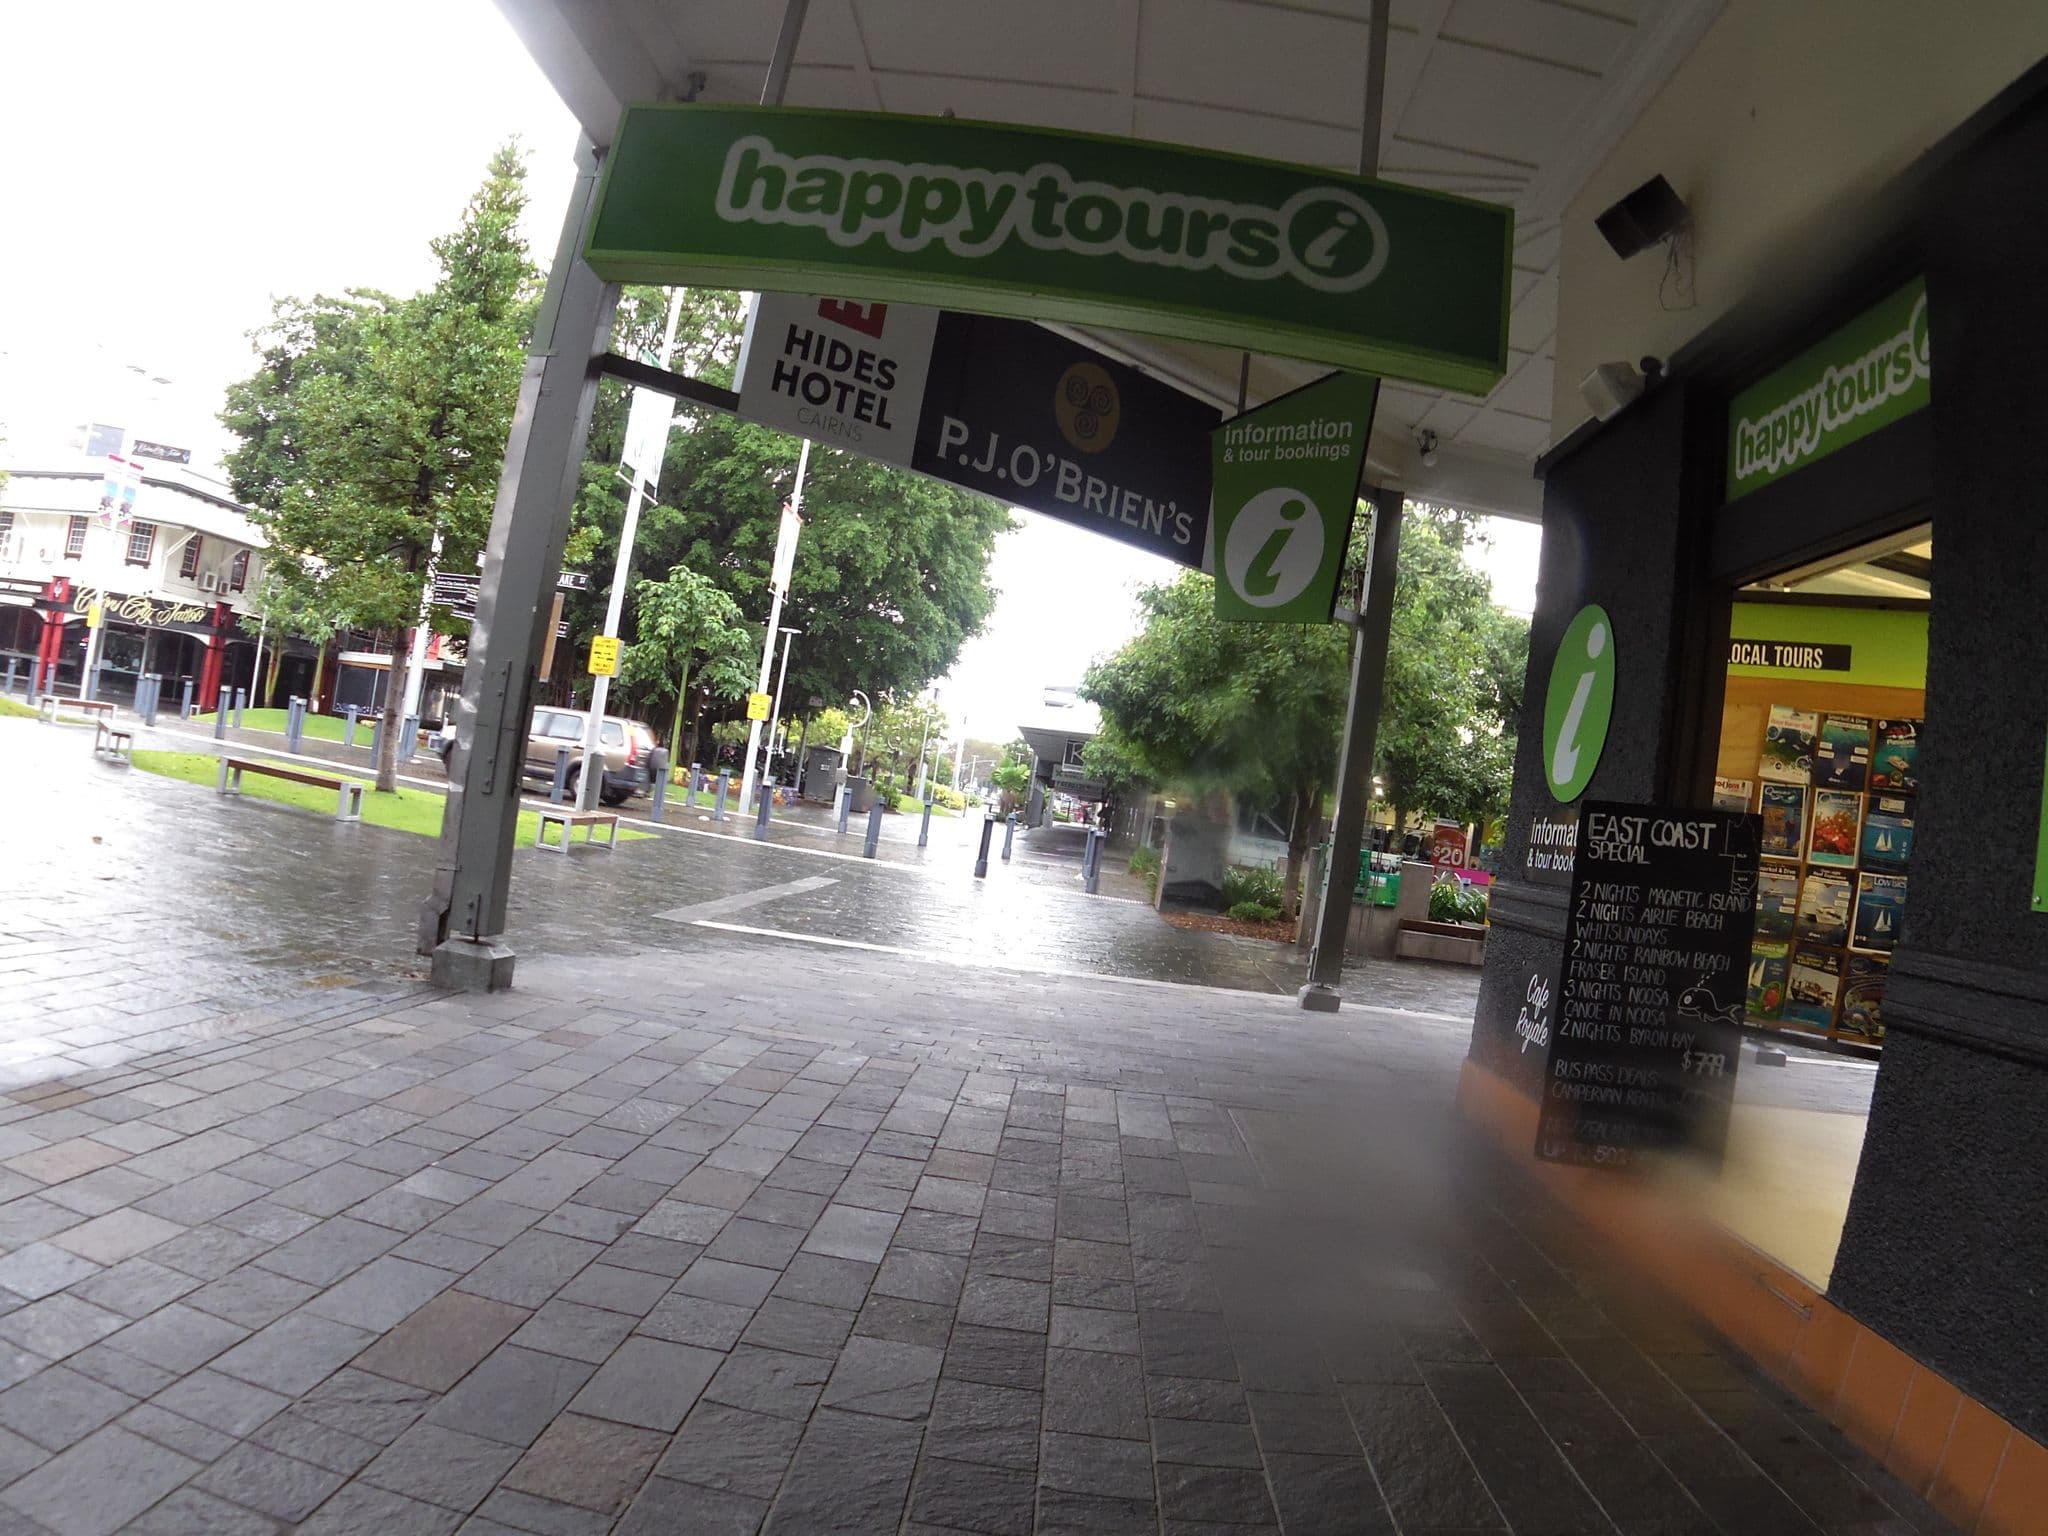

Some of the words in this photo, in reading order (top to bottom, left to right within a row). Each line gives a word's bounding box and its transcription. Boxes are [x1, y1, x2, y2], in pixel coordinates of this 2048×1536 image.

[784, 323, 898, 391] HIDES
[771, 359, 892, 431] HOTEL
[797, 407, 863, 443] CAIRNS
[1224, 418, 1353, 446] information
[1223, 447, 1234, 463] &
[1239, 447, 1270, 462] tour
[1274, 442, 1350, 461] bookings
[557, 573, 575, 586] AKE
[1727, 643, 1769, 666] OCAL
[1774, 646, 1823, 669] TOURS
[1588, 812, 1650, 844] EAST
[1650, 818, 1717, 850] COAST
[1432, 846, 1464, 866] $20
[1527, 848, 1534, 868] &
[1535, 849, 1551, 870] tour
[1587, 840, 1651, 864] SPECIAL
[1579, 880, 1591, 899] 2
[1593, 883, 1640, 903] NIGHTS
[1648, 887, 1703, 909] MAGNETIC
[1708, 893, 1750, 913] ISLAND
[1576, 900, 1587, 918] 2
[1590, 902, 1634, 924] NIGHTS
[1640, 907, 1679, 927] AIRLIE
[1685, 911, 1723, 931] BEACH
[1575, 921, 1670, 945] WHITSUNDAYS
[1571, 939, 1582, 958] 2
[1584, 942, 1629, 962] NIGHTS
[1634, 947, 1690, 969] RAINBOW
[1693, 952, 1732, 972] BEACH
[1569, 960, 1616, 981] FRASER
[1623, 965, 1666, 986] ISLAND
[1526, 974, 1549, 1020] Cafe
[1564, 979, 1576, 997] 3
[1577, 981, 1622, 1001] NIGHTS
[1628, 986, 1669, 1007] NOOSA
[1564, 1000, 1603, 1019] CANOE
[1626, 1006, 1666, 1026] NOOSA
[1514, 1006, 1548, 1053] Royale
[1560, 1018, 1570, 1036] 2
[1571, 1021, 1621, 1042] NIGHTS
[1630, 1029, 1669, 1047] BYRON
[1672, 1031, 1696, 1050] BAY
[1555, 1059, 1582, 1079] BUS
[1583, 1063, 1614, 1082] PASS
[1552, 1081, 1624, 1105] CAMPERVAN
